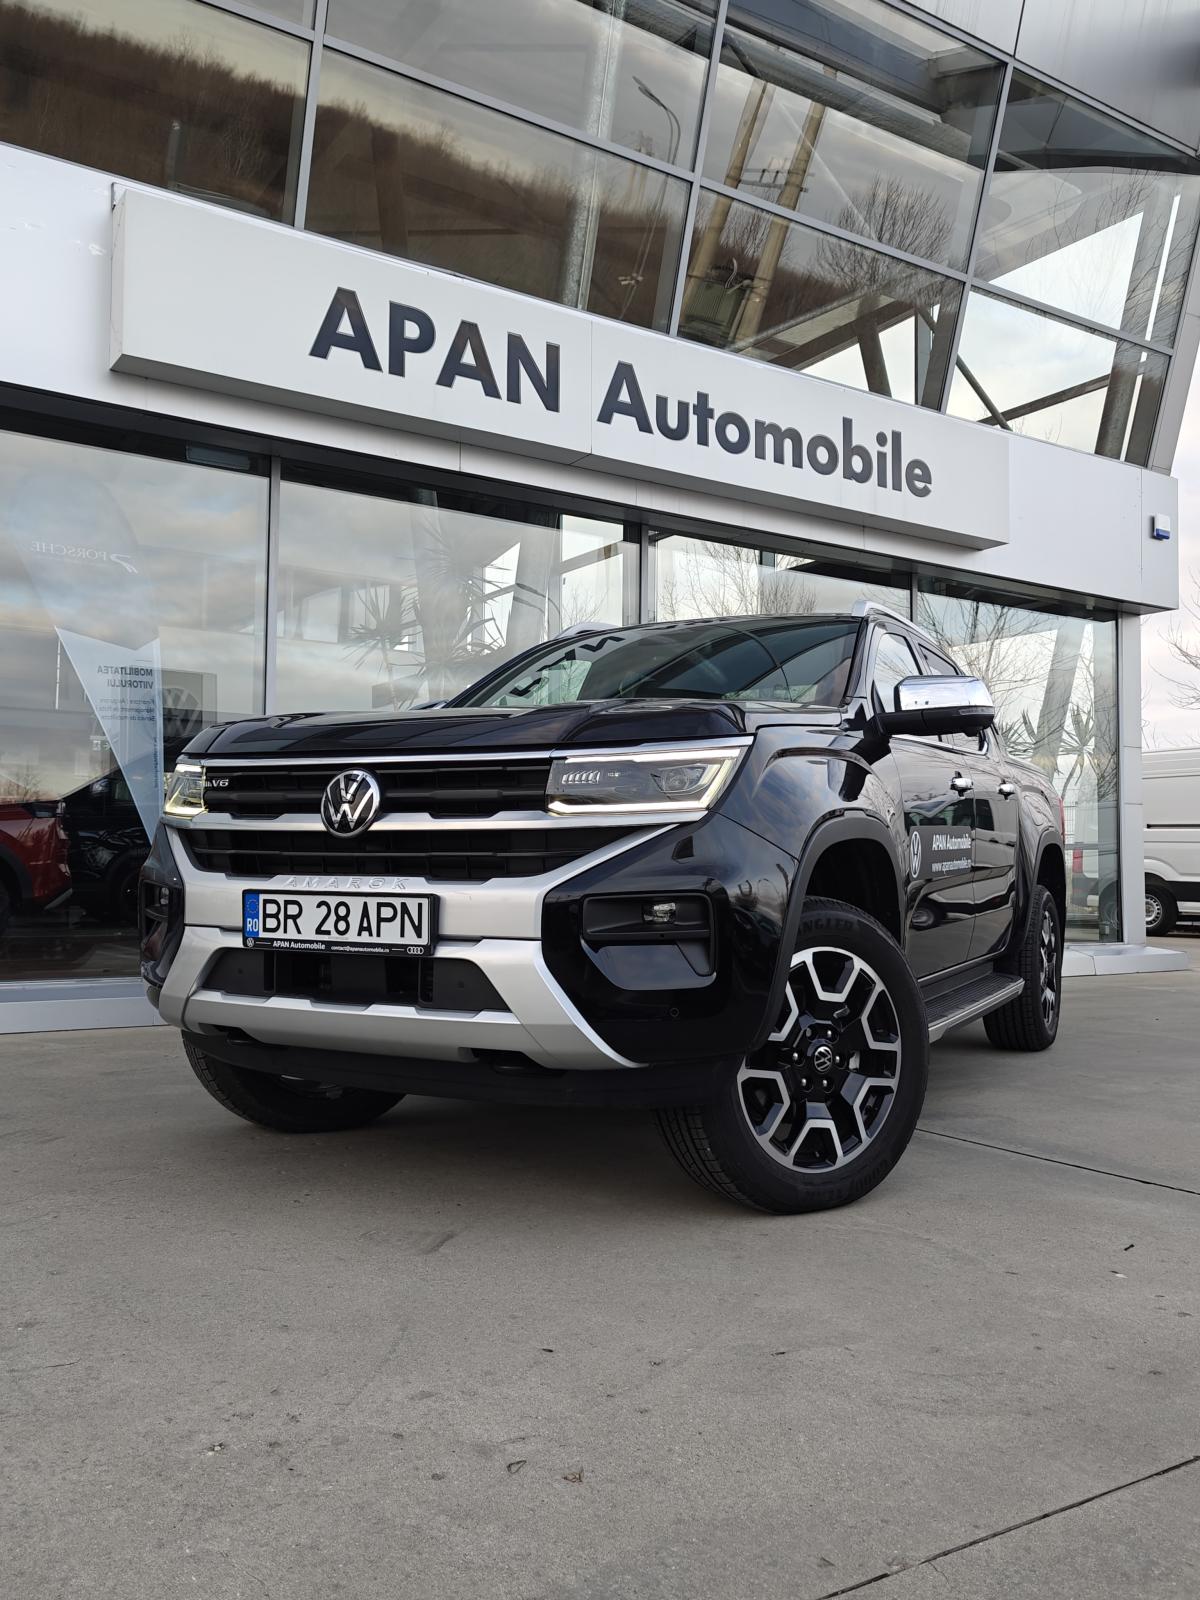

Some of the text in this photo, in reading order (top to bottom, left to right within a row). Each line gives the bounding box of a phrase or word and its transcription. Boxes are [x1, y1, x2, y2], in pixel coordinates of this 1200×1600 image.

[309, 287, 933, 498] APAN Automobile
[211, 778, 229, 788] V6
[932, 833, 971, 851] APAN Automobile
[282, 876, 410, 890] AMAROK
[246, 918, 259, 933] RO
[262, 899, 423, 939] BR 28 APN
[273, 940, 289, 948] APAN
[290, 940, 326, 950] Automobile
